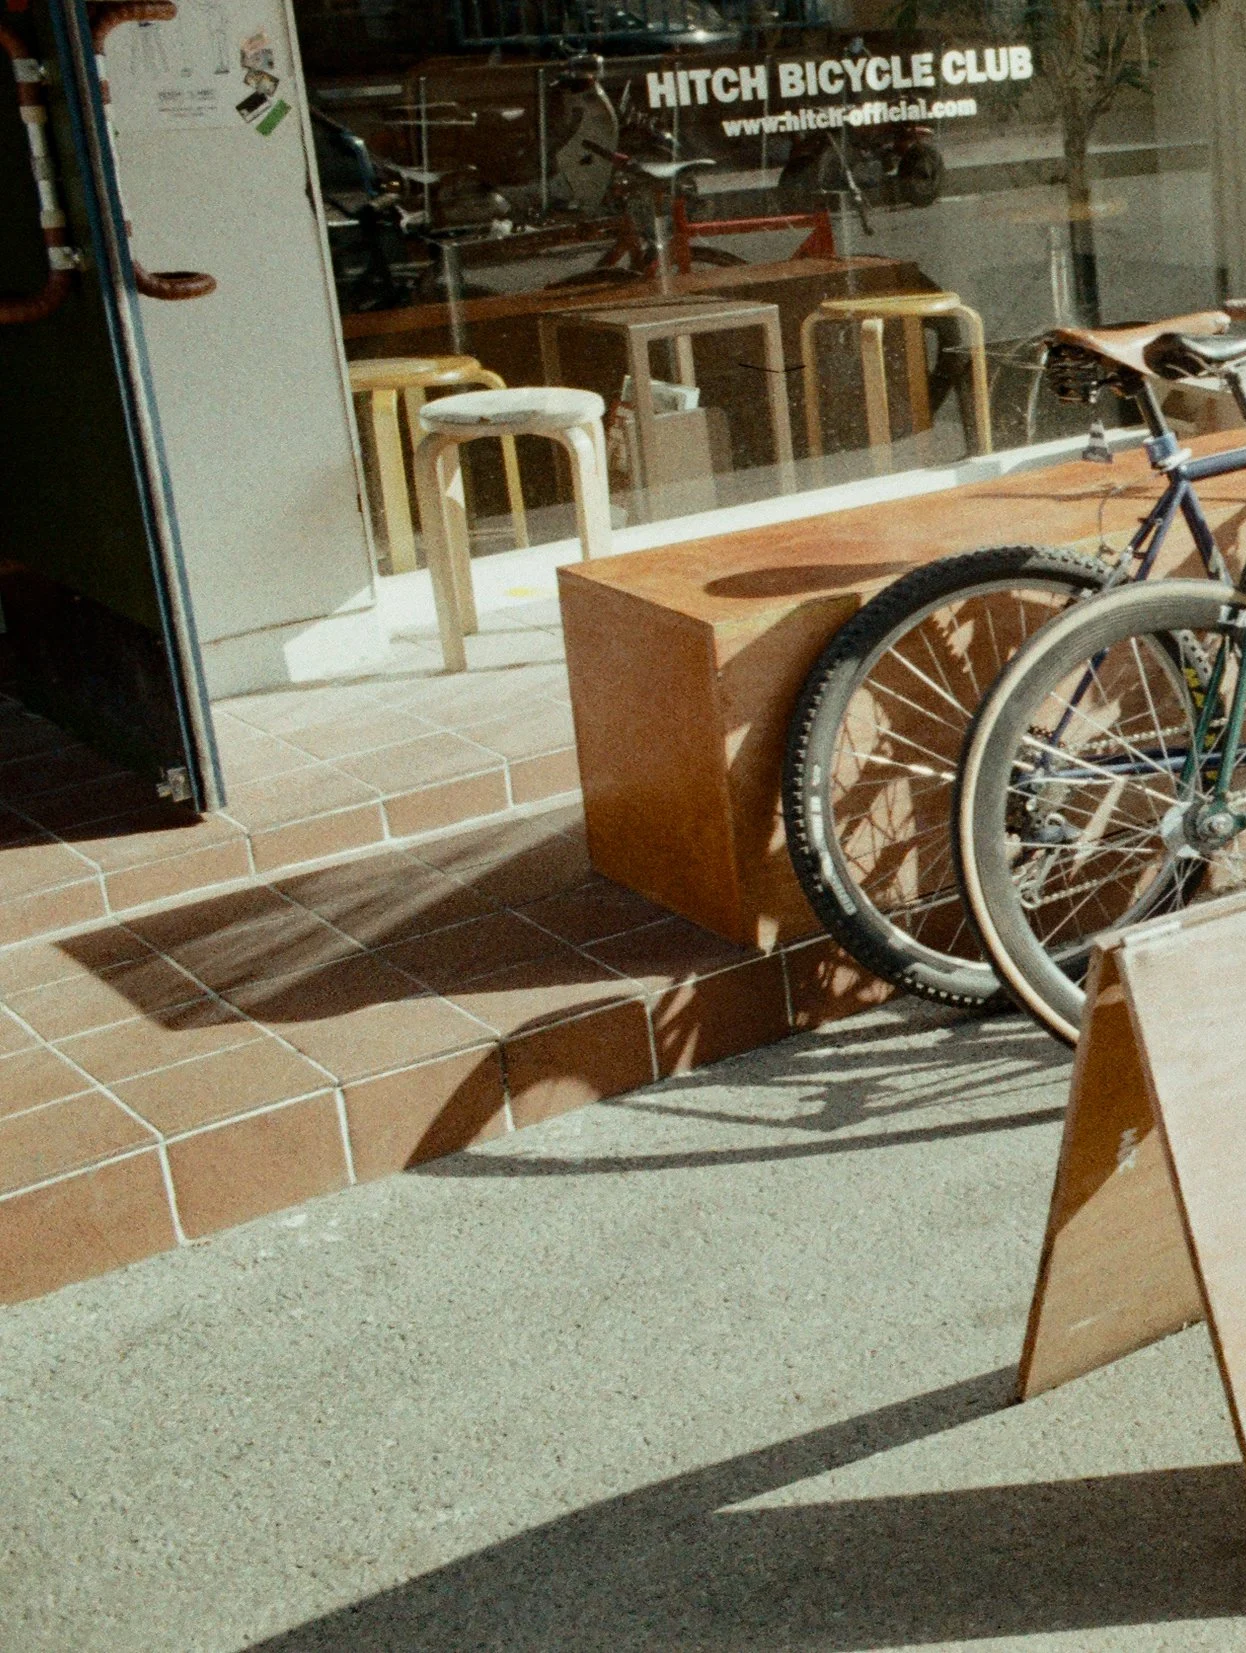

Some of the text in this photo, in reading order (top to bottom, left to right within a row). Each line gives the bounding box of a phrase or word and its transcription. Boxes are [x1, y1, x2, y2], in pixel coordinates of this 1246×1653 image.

[646, 45, 1034, 108] HITCH BICYCLE CLUB
